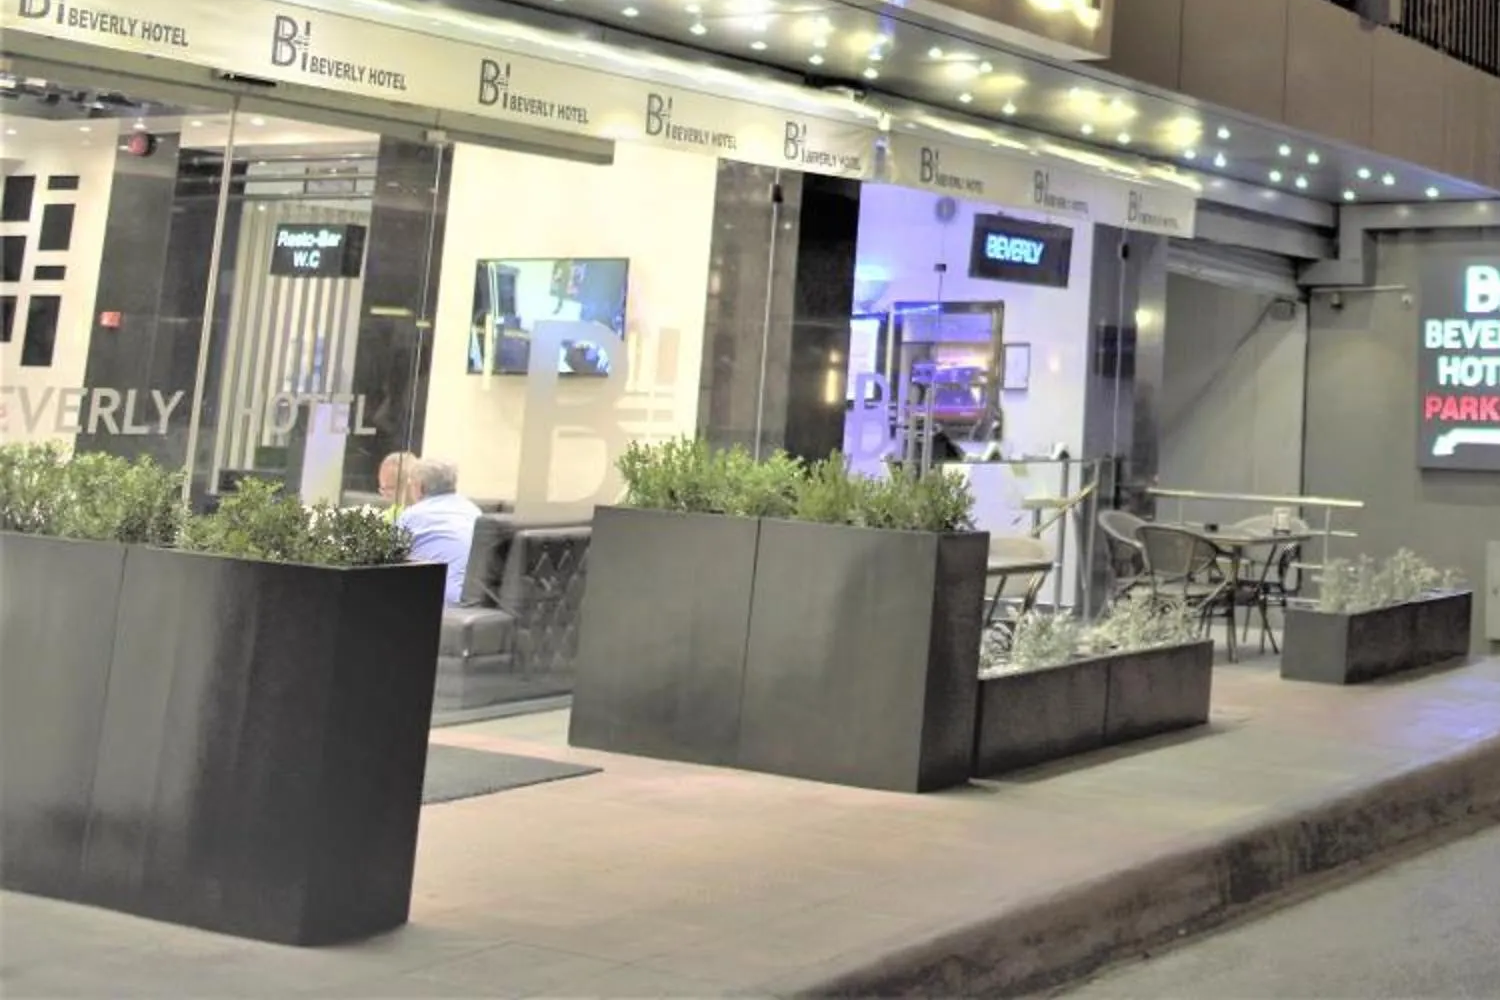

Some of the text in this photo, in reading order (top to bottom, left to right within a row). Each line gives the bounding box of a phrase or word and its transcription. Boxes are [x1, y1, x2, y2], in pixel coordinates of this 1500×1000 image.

[68, 7, 138, 37] BEVERLY
[141, 22, 189, 47] HOTEL
[310, 55, 367, 83] BEVERLY
[368, 69, 407, 90] HOTEL
[509, 95, 555, 118] BEVERLY
[557, 103, 589, 124] HOTEL
[986, 232, 1045, 265] BEVERLY
[233, 391, 377, 435] HOTEL
